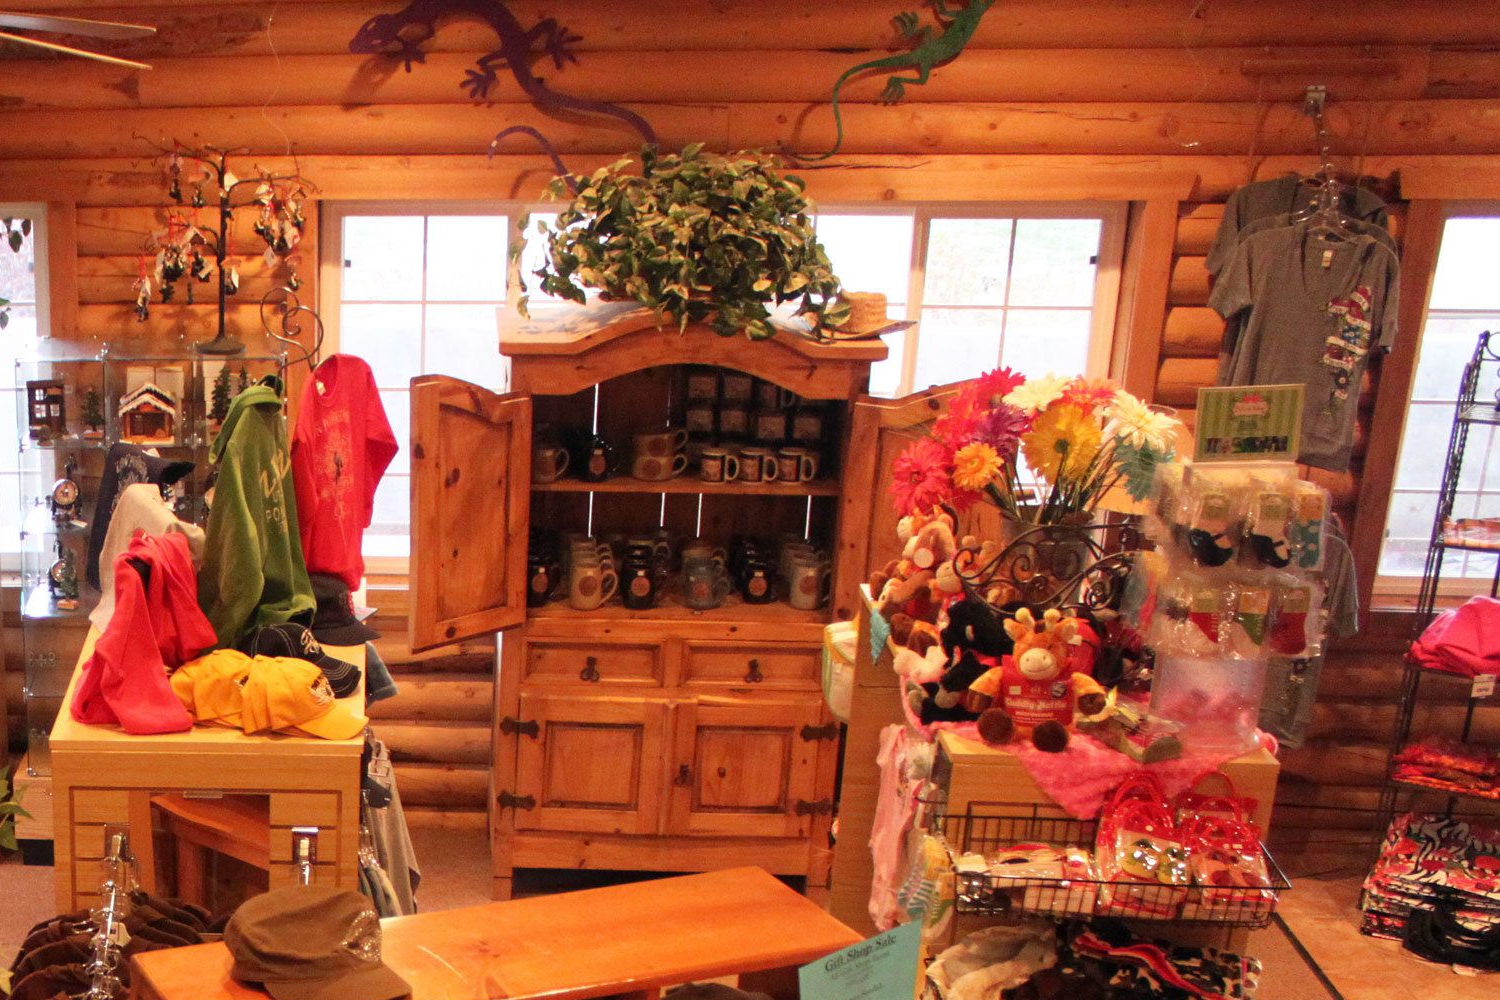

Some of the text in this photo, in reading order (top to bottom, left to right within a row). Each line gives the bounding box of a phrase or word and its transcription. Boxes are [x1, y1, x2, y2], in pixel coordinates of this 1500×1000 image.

[824, 955, 847, 972] Gift
[847, 944, 873, 959] Shop
[875, 935, 897, 947] Sale
